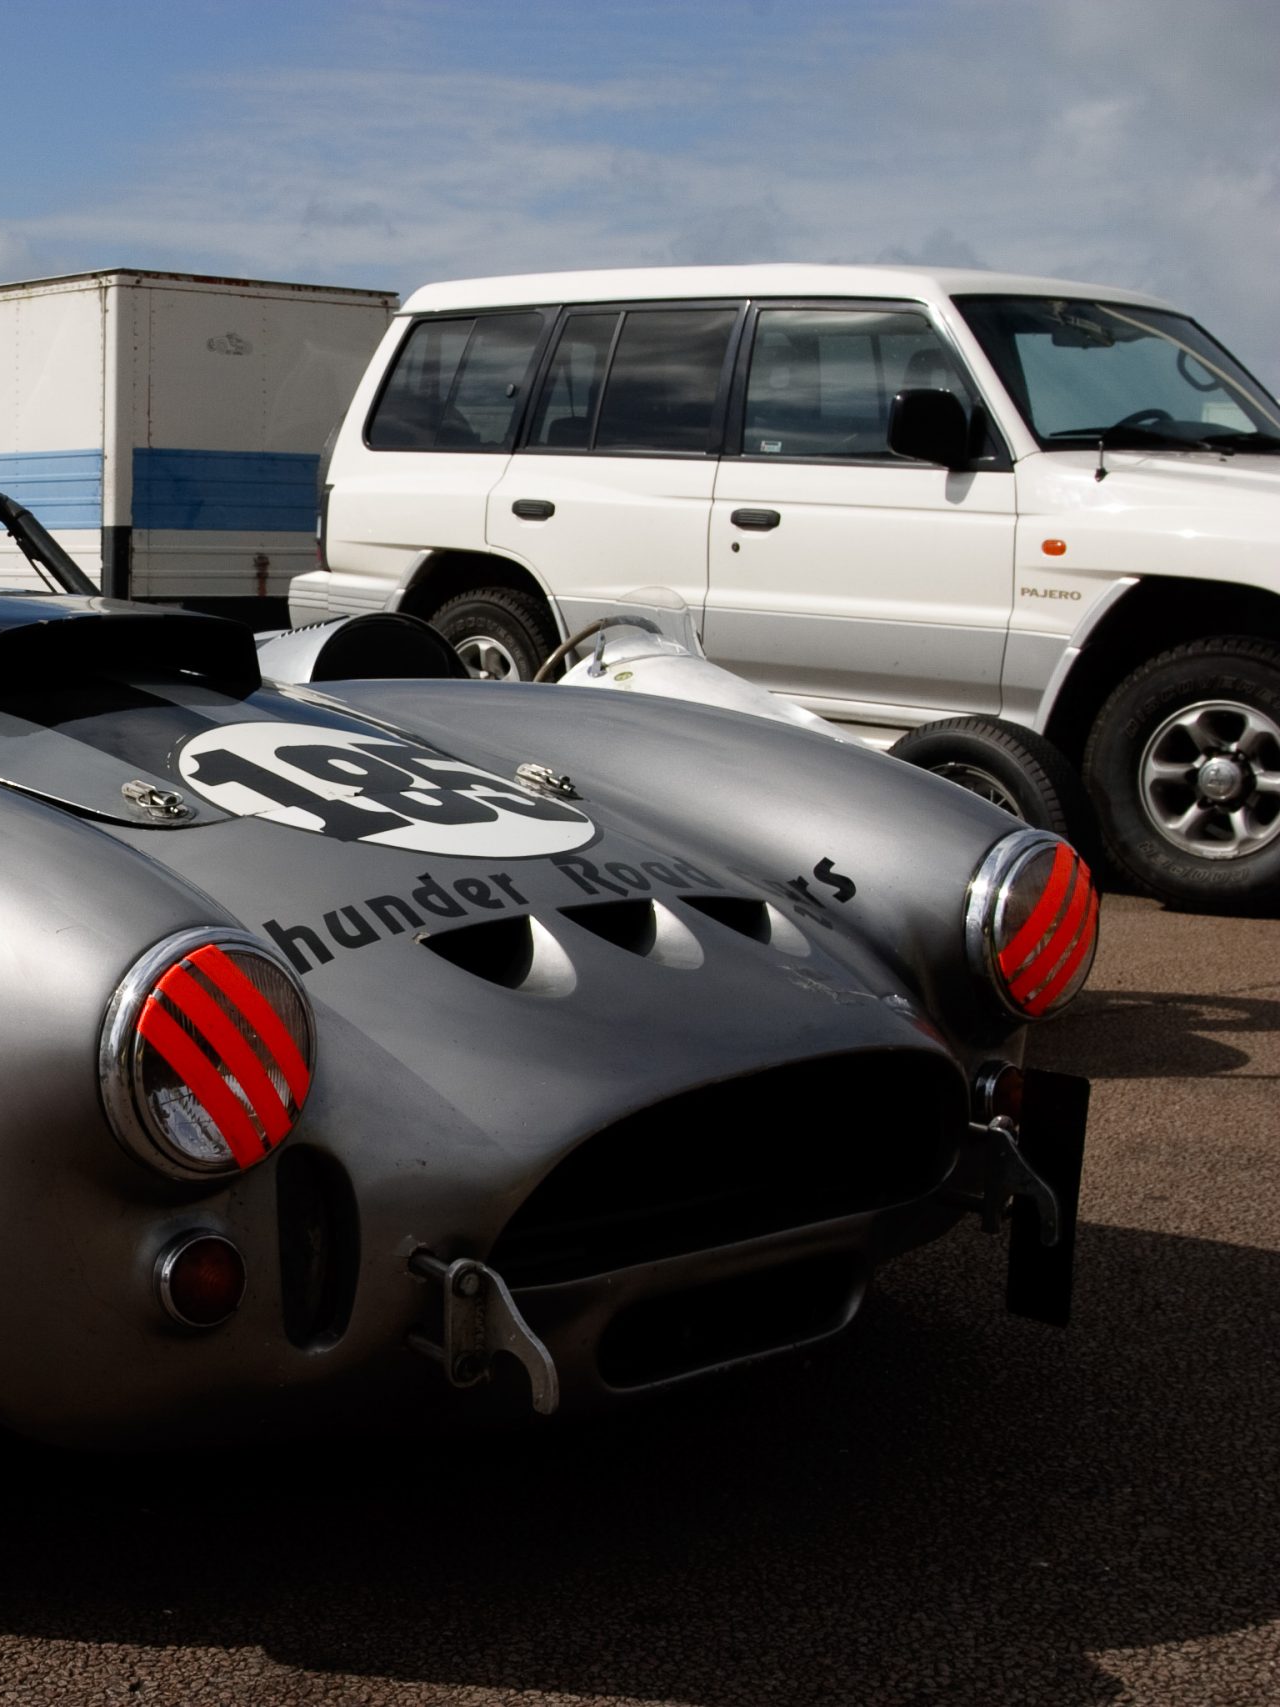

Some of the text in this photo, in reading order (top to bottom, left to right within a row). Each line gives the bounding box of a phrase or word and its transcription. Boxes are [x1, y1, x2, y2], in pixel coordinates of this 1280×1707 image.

[1020, 587, 1082, 601] PAJERO
[188, 742, 591, 842] 185
[262, 872, 530, 976] hunder
[549, 855, 726, 898] Road
